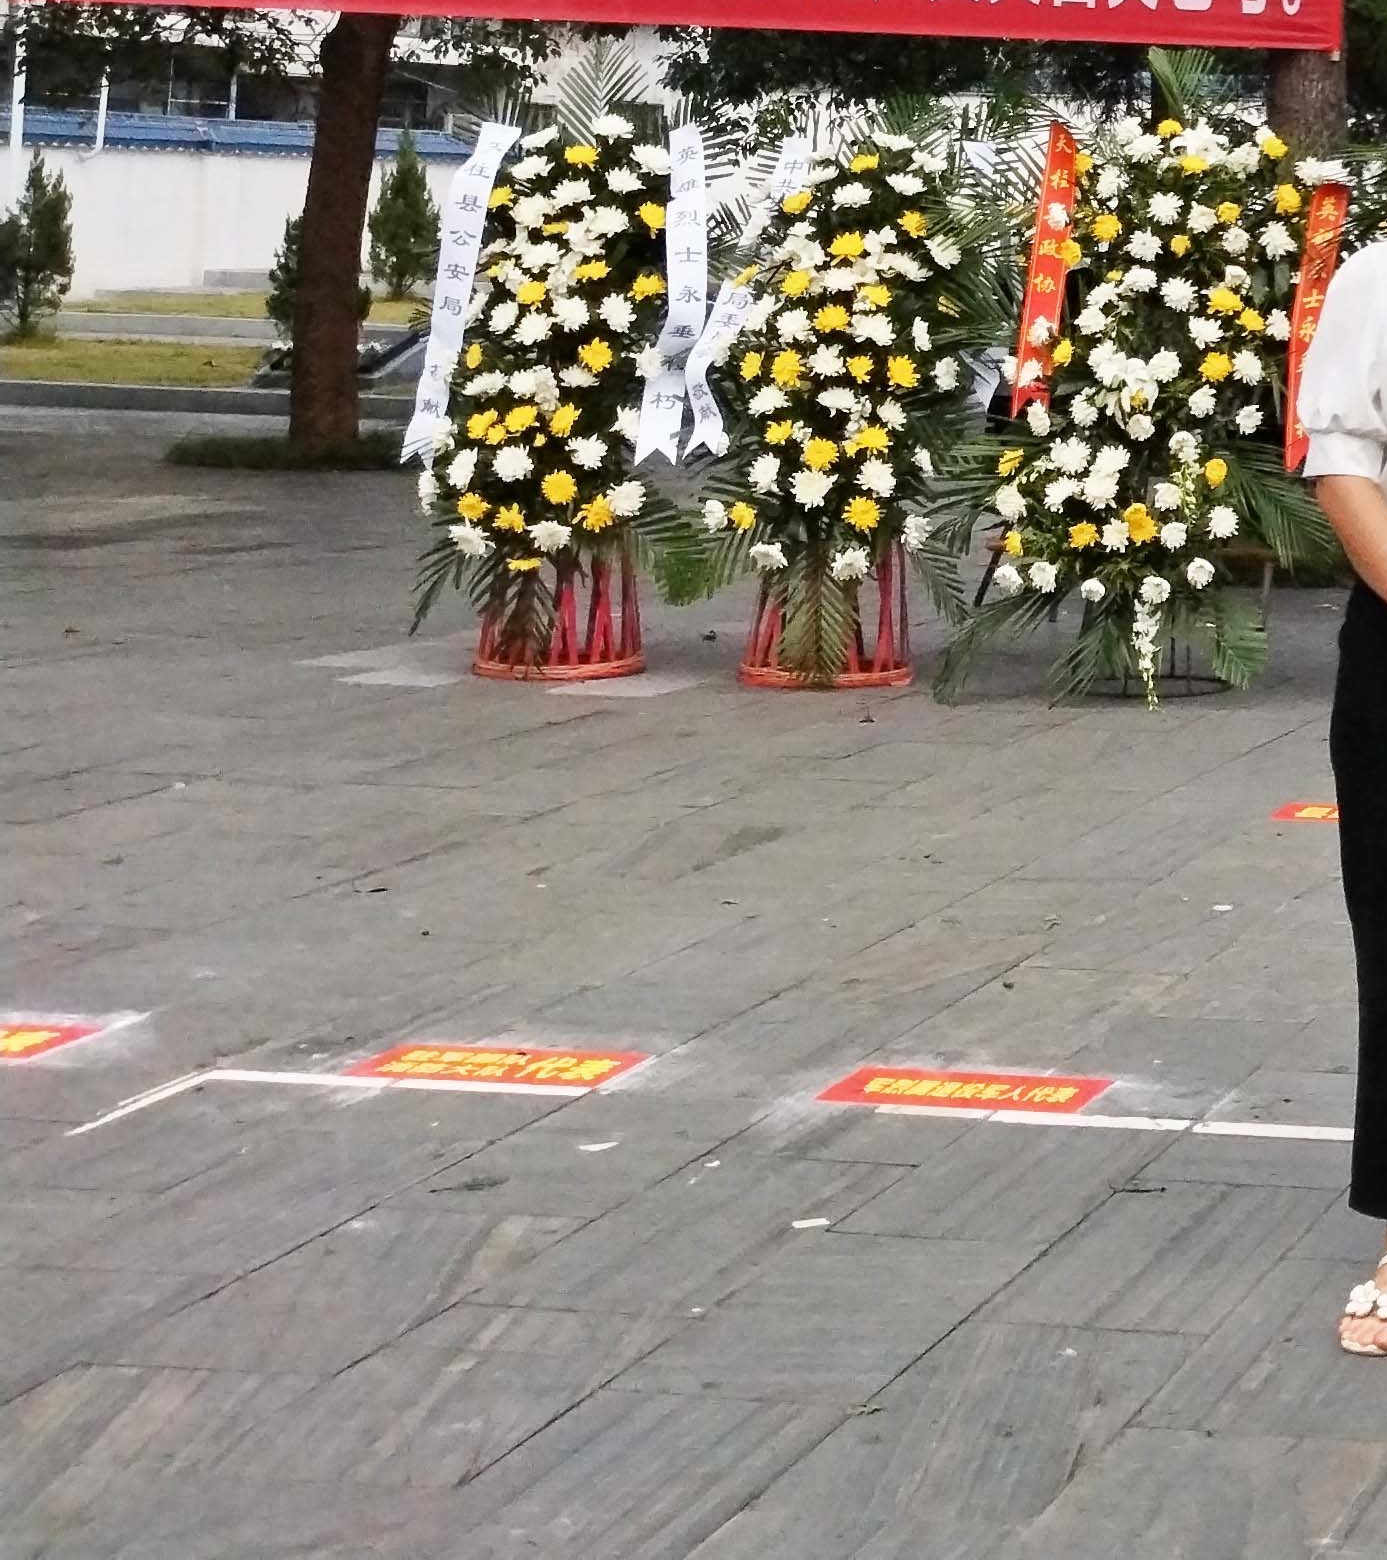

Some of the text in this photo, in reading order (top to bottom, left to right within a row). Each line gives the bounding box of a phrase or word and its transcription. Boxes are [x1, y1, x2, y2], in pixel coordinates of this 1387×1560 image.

[649, 145, 704, 411] 英雄烈士永垂朽
[1033, 134, 1073, 294] 天柱政协
